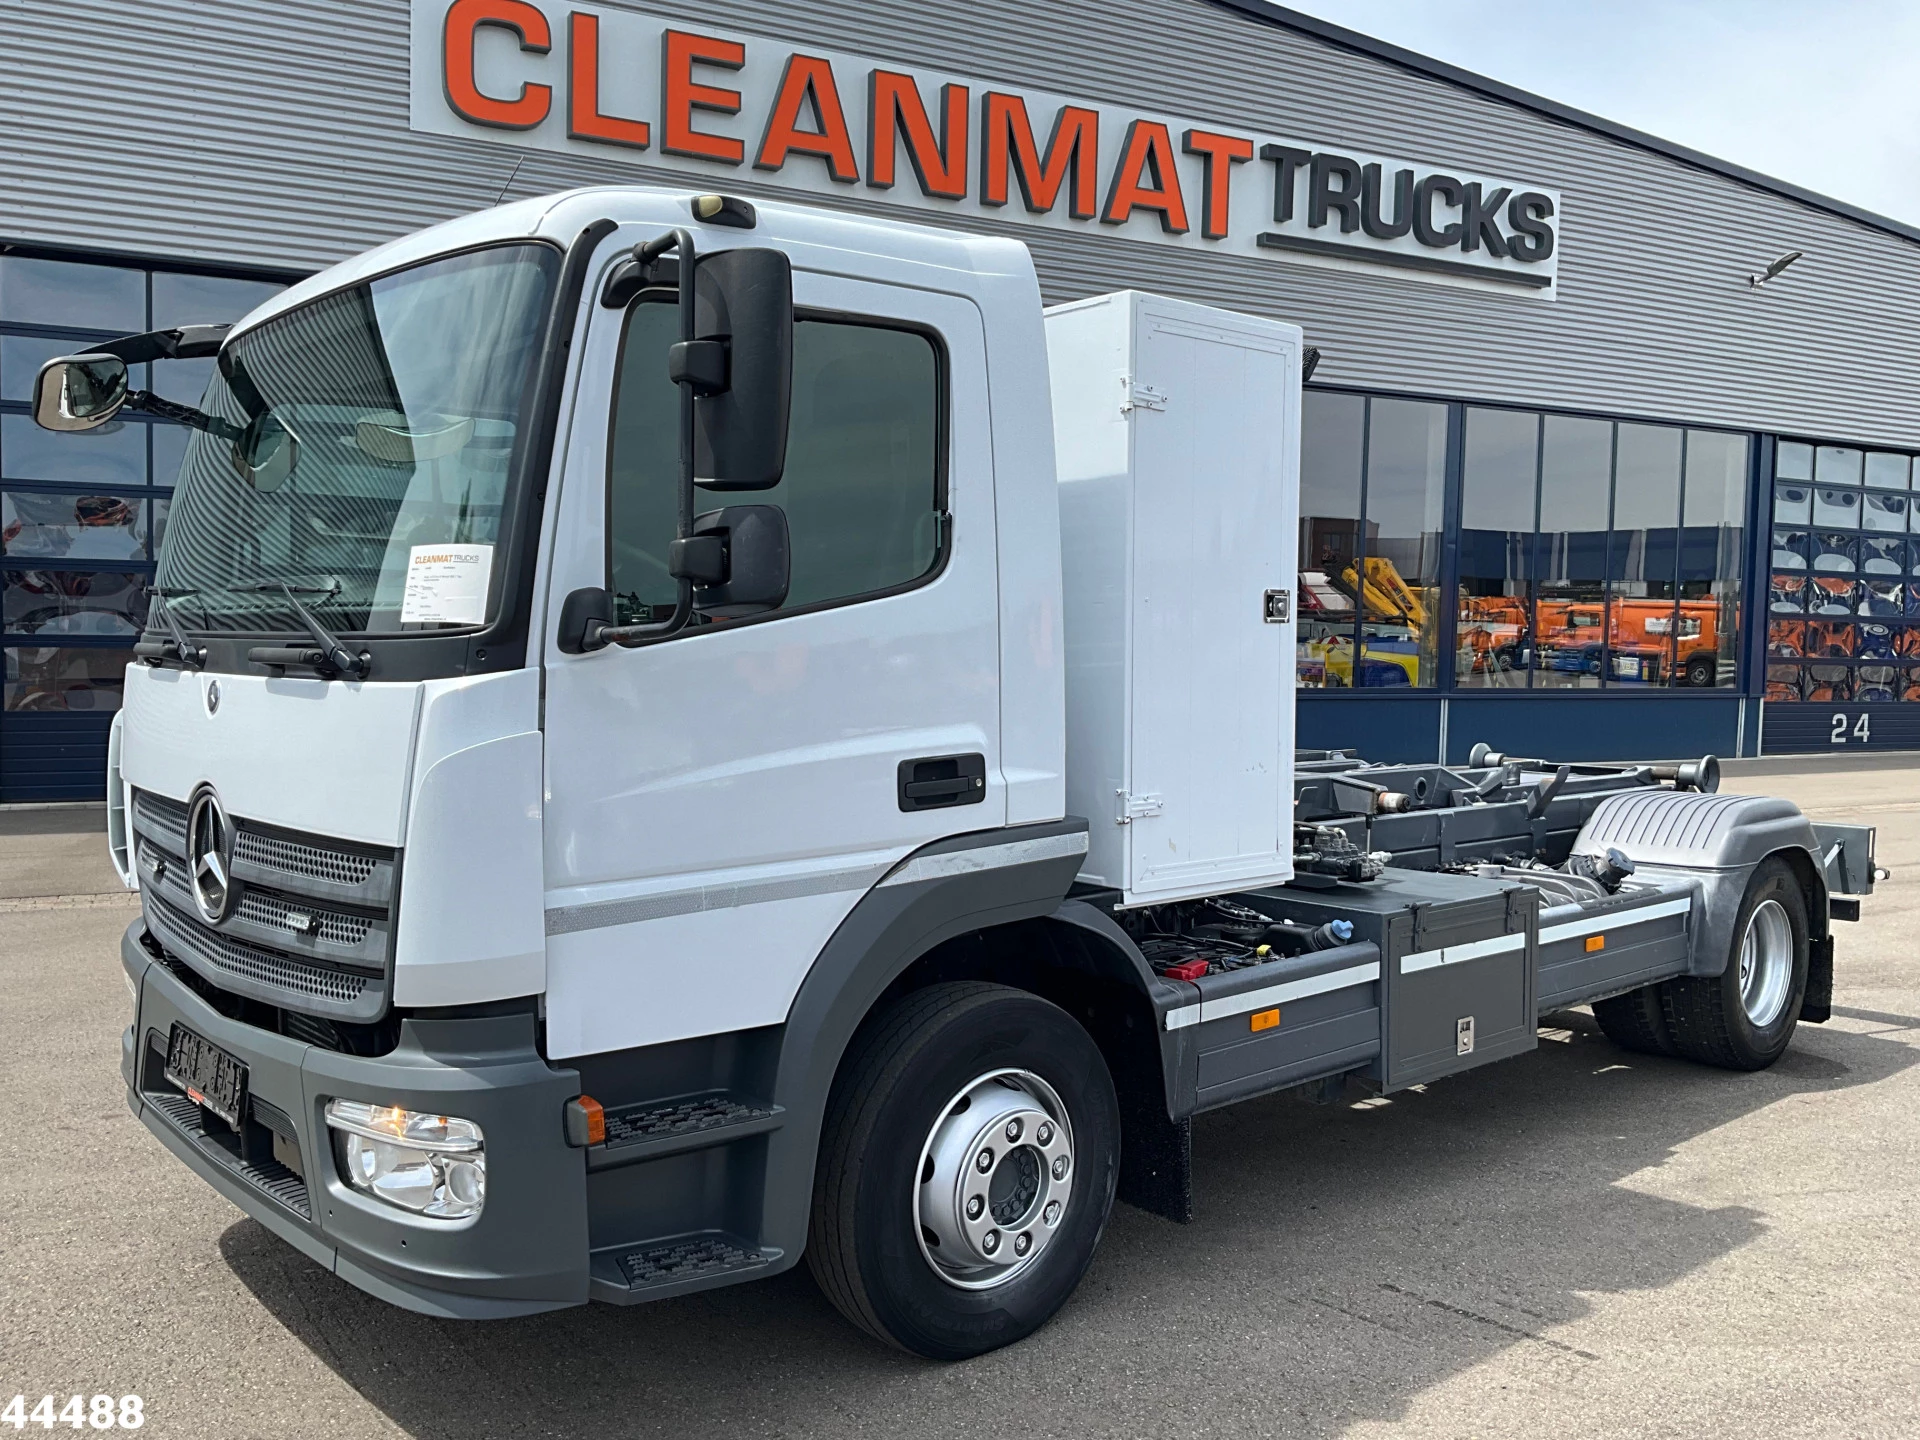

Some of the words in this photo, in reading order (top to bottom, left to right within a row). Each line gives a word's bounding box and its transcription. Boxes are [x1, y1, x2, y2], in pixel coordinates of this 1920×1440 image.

[441, 0, 1254, 241] CLEANMAT
[1259, 143, 1554, 263] TRUCKS
[415, 554, 453, 564] CLEANMAT
[453, 554, 479, 562] TRUCKS
[1831, 713, 1870, 743] 24
